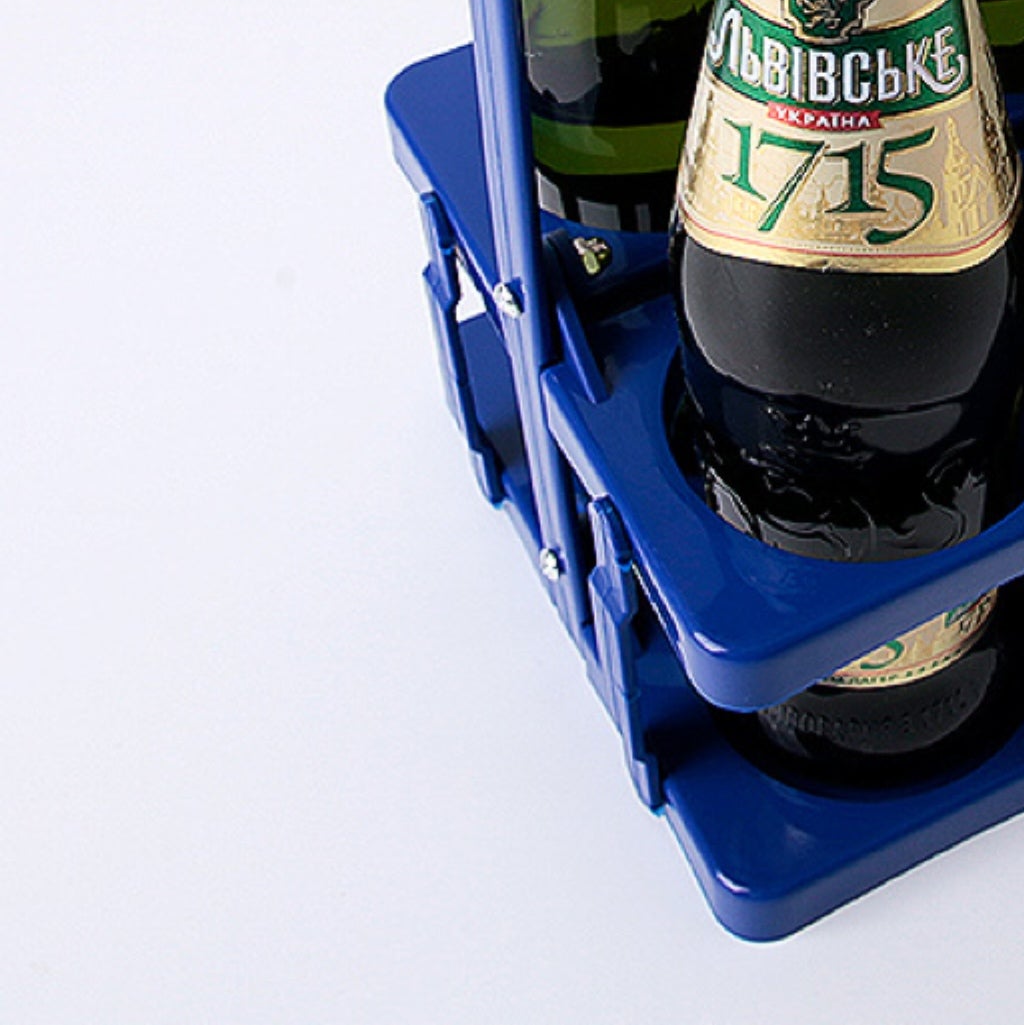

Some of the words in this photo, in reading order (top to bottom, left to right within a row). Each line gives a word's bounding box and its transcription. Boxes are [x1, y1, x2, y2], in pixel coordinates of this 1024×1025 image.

[710, 7, 967, 105] ЛЬВІВСЬКЕ
[775, 107, 871, 129] УКРАЇНА
[722, 119, 937, 245] 1715
